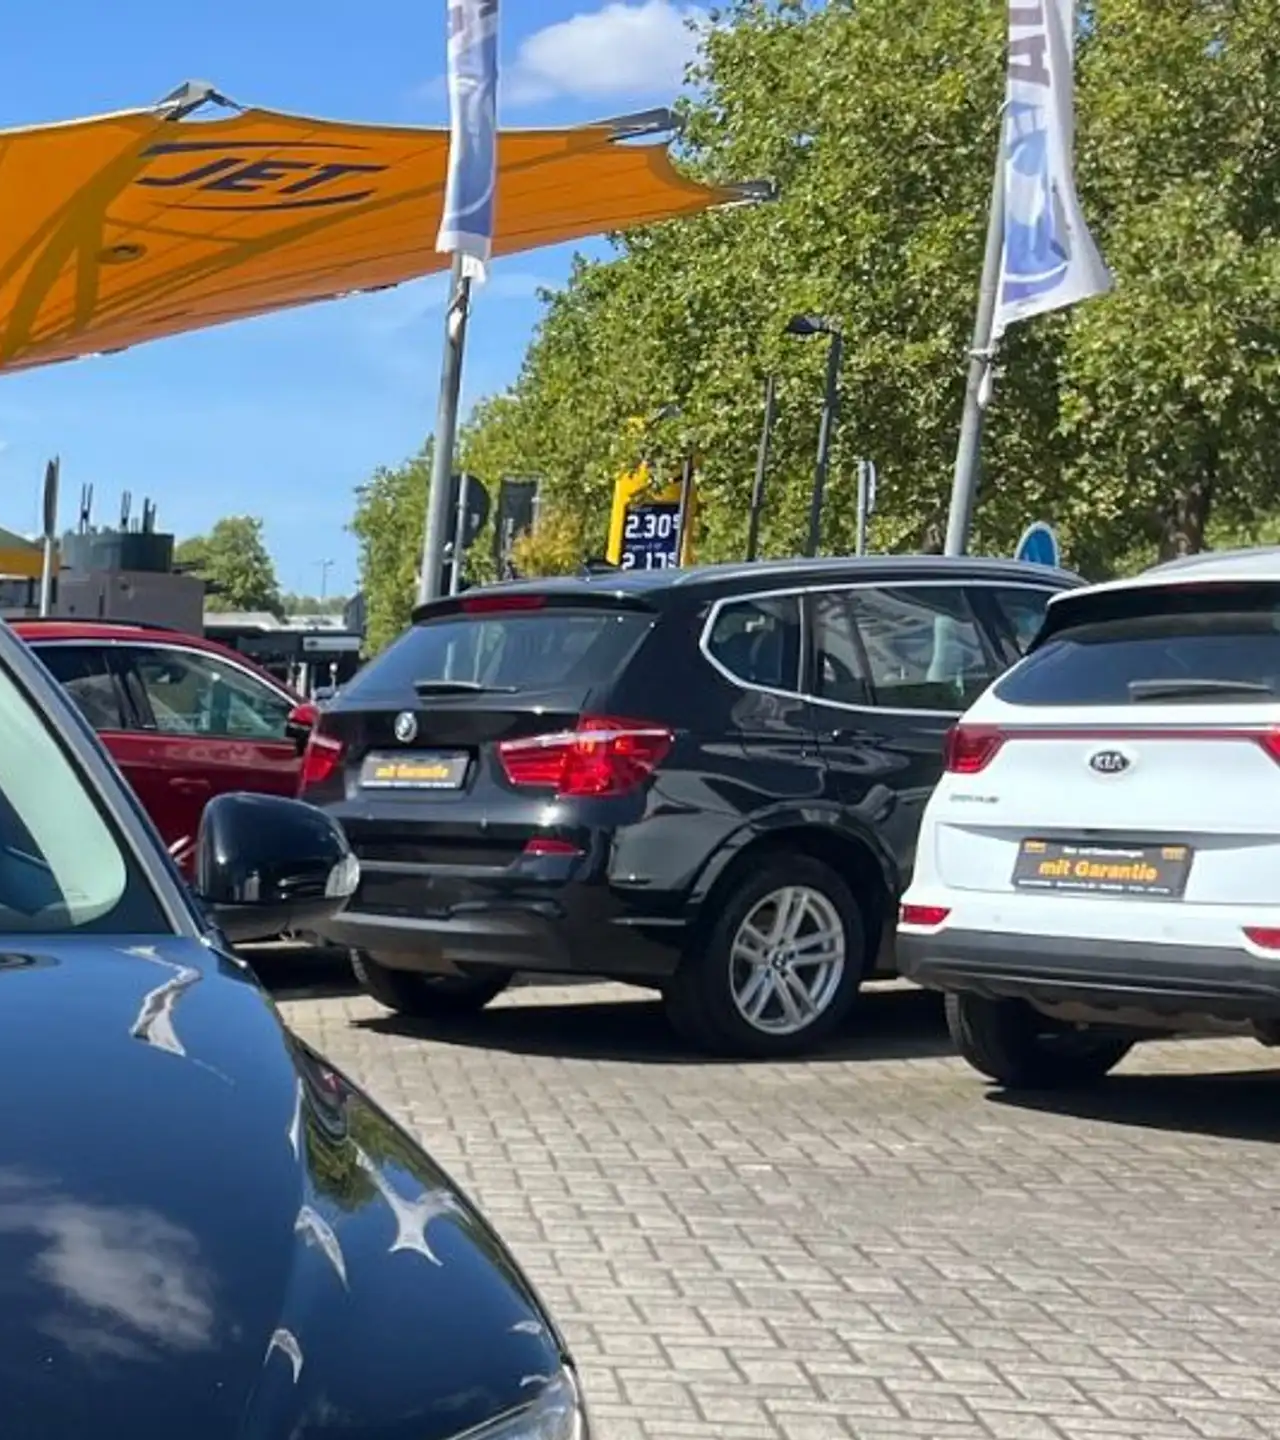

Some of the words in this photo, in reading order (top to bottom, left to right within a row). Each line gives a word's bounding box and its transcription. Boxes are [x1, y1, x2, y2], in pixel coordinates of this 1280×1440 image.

[136, 157, 389, 195] JET
[1039, 859, 1073, 877] mit
[1074, 861, 1159, 882] Garantie
